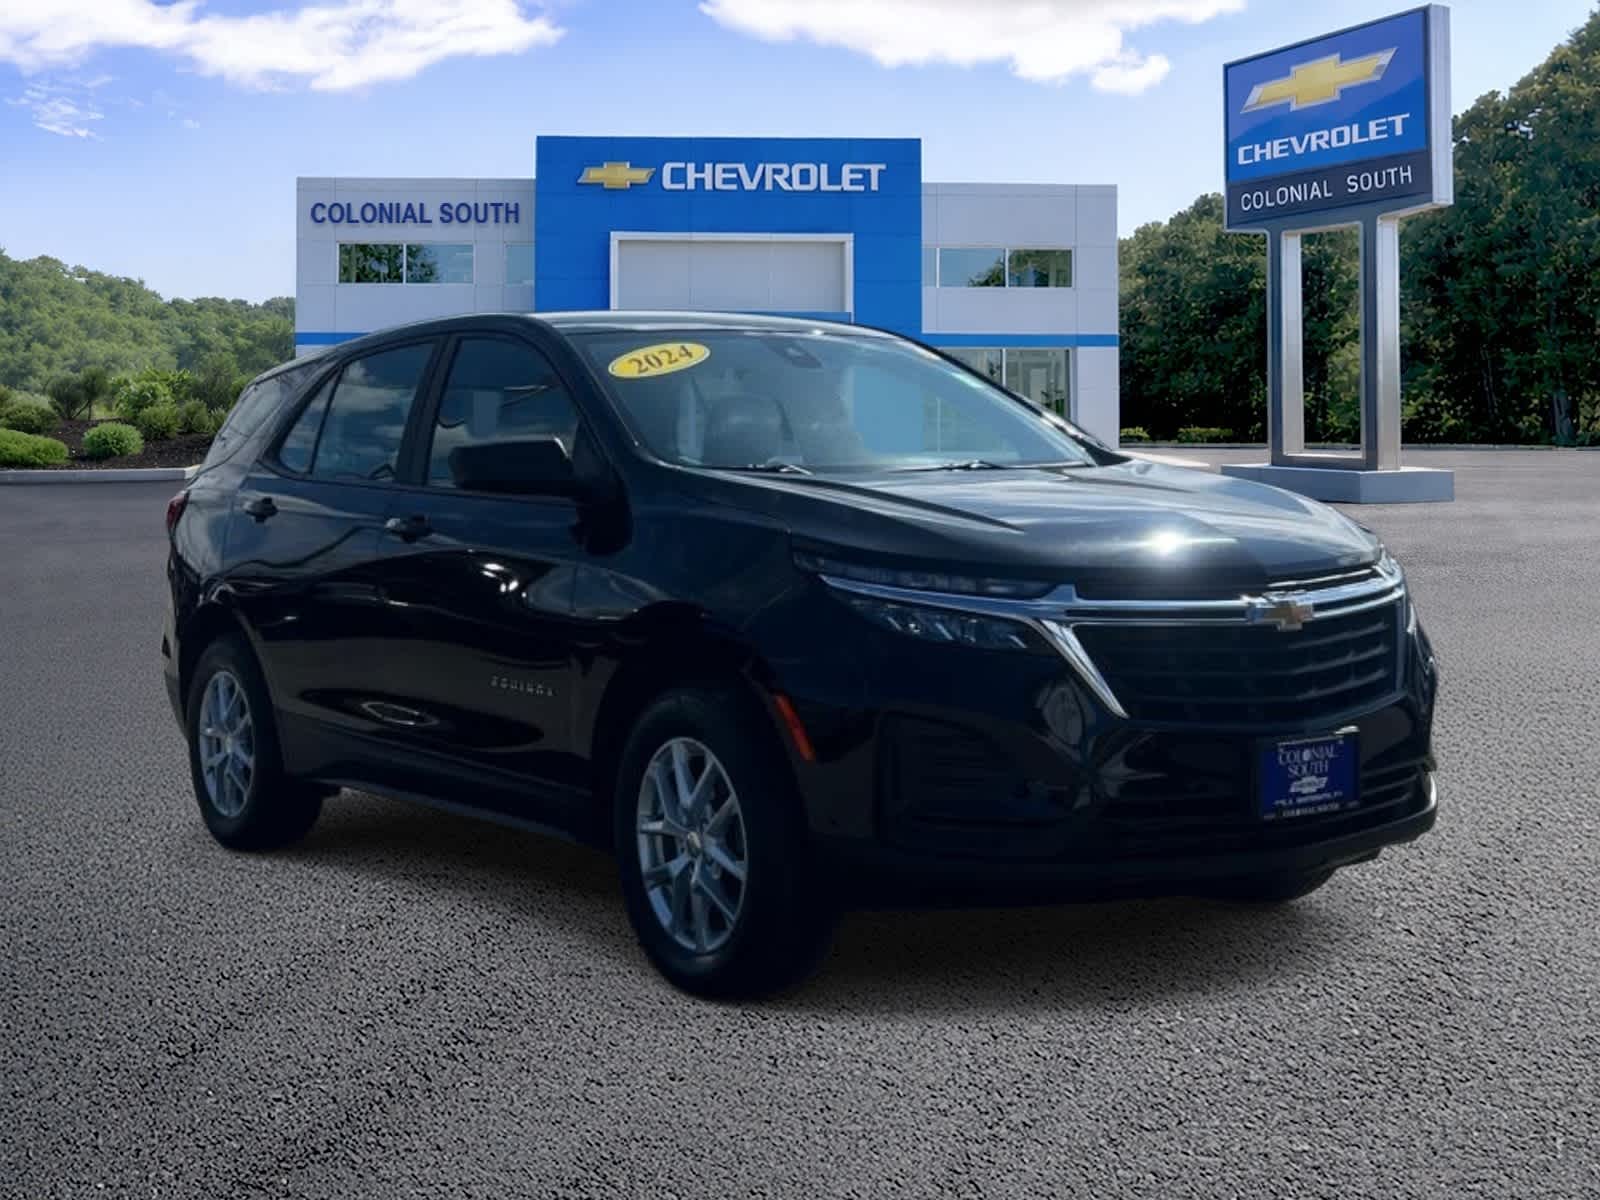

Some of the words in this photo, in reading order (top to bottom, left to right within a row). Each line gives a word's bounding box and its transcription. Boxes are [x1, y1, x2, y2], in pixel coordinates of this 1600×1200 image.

[1237, 113, 1410, 165] CHEVROLET
[662, 162, 887, 191] CHEVROLET
[1241, 180, 1332, 211] COLONIAL
[1346, 165, 1412, 193] SOUTH
[310, 202, 433, 225] COLONIAL
[439, 202, 520, 225] SOUTH
[628, 344, 693, 375] 2024
[1287, 759, 1328, 778] SOUTH
